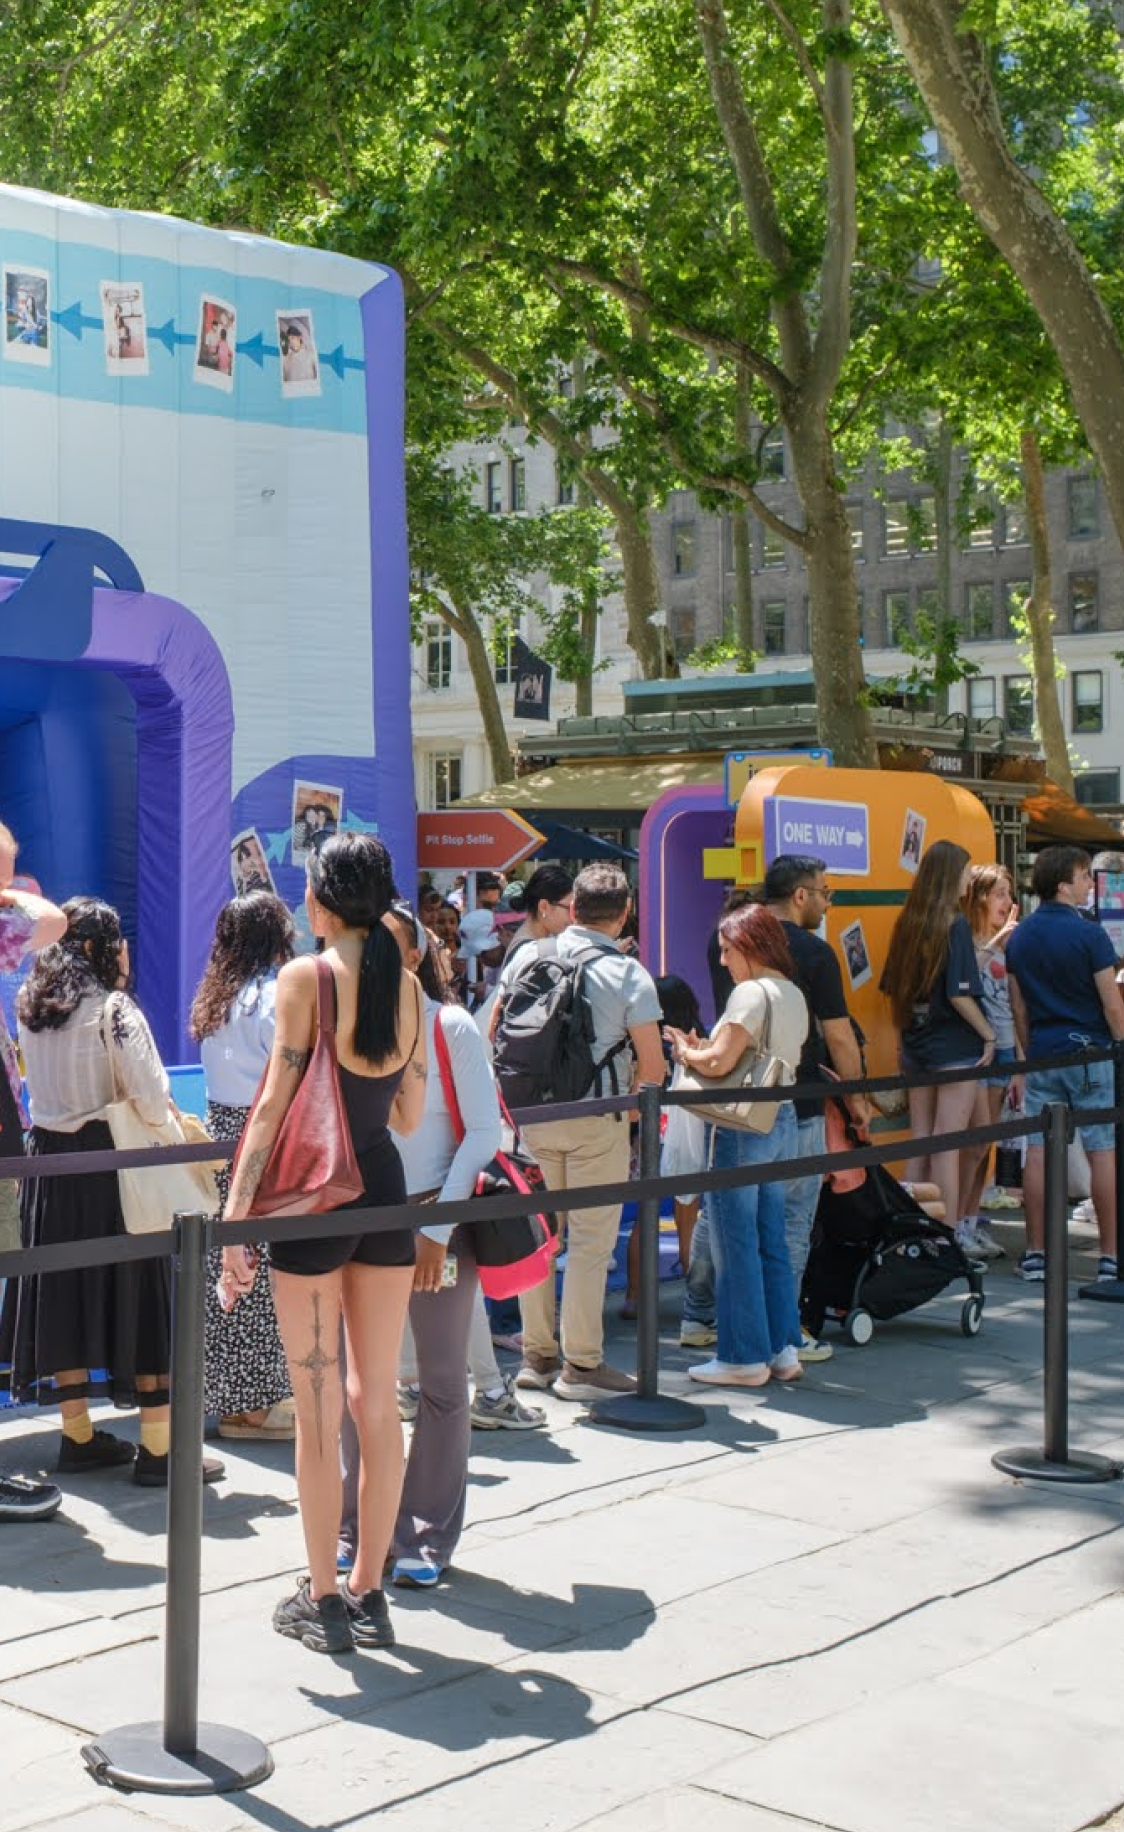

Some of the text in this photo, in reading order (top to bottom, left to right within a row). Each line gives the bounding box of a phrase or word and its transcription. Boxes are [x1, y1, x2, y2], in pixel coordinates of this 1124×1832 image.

[425, 833, 495, 846] Pit Stop Selfie
[783, 821, 845, 846] ONE WAY
